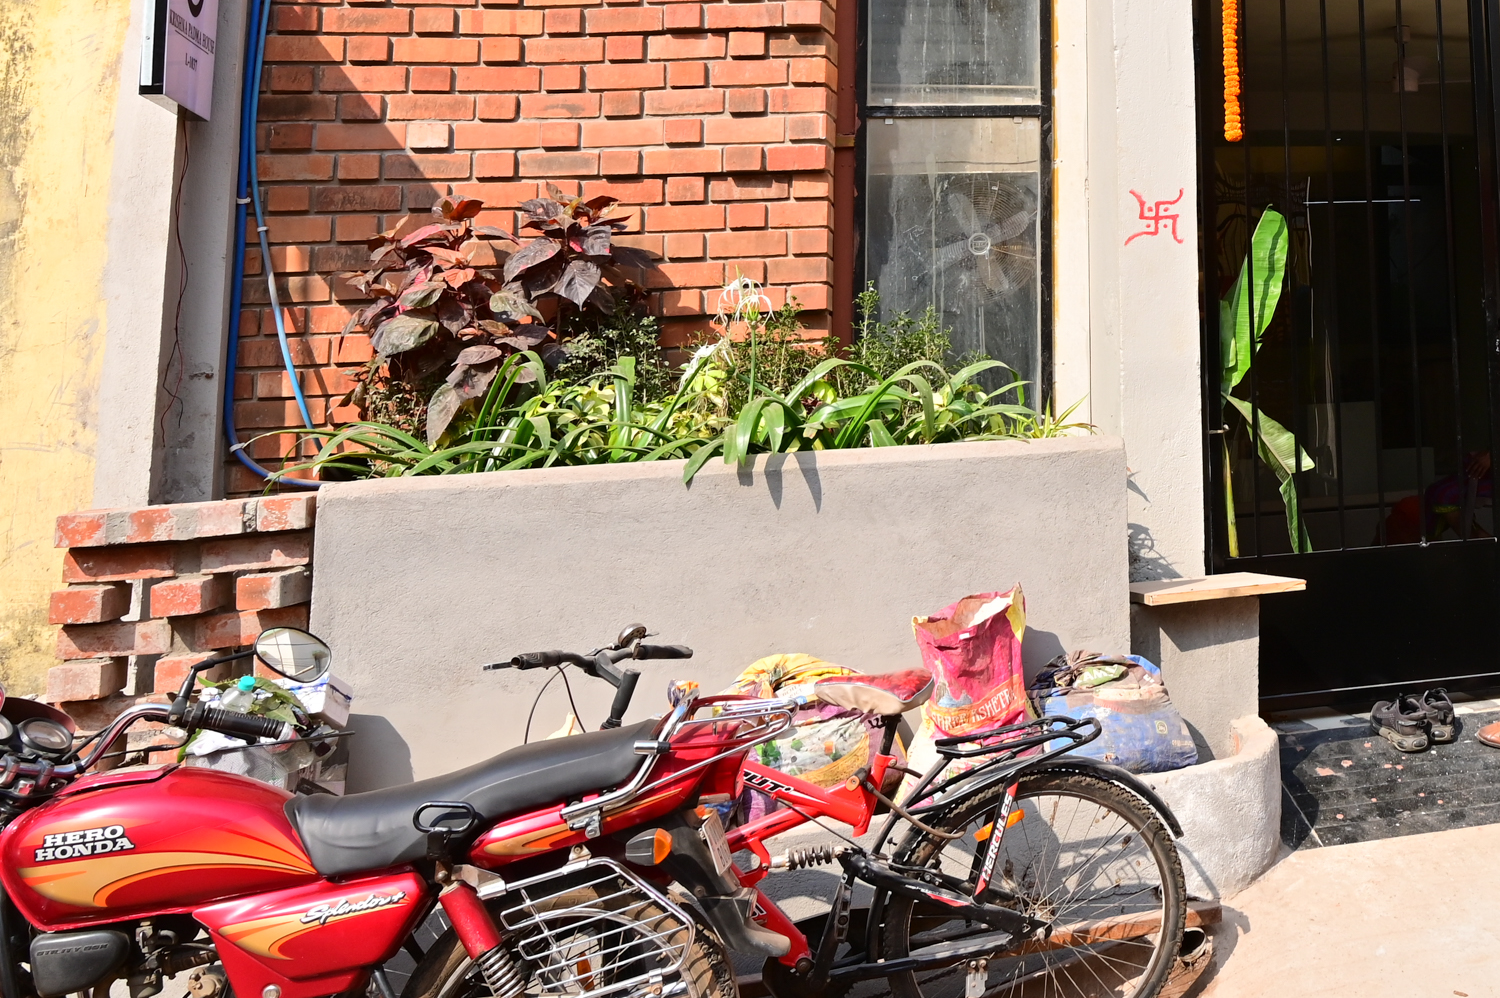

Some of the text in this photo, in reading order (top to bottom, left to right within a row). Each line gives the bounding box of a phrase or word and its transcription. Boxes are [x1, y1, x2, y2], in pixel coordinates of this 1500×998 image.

[202, 33, 215, 55] HOUSE
[43, 825, 124, 848] HERO
[35, 837, 134, 862] HONDA
